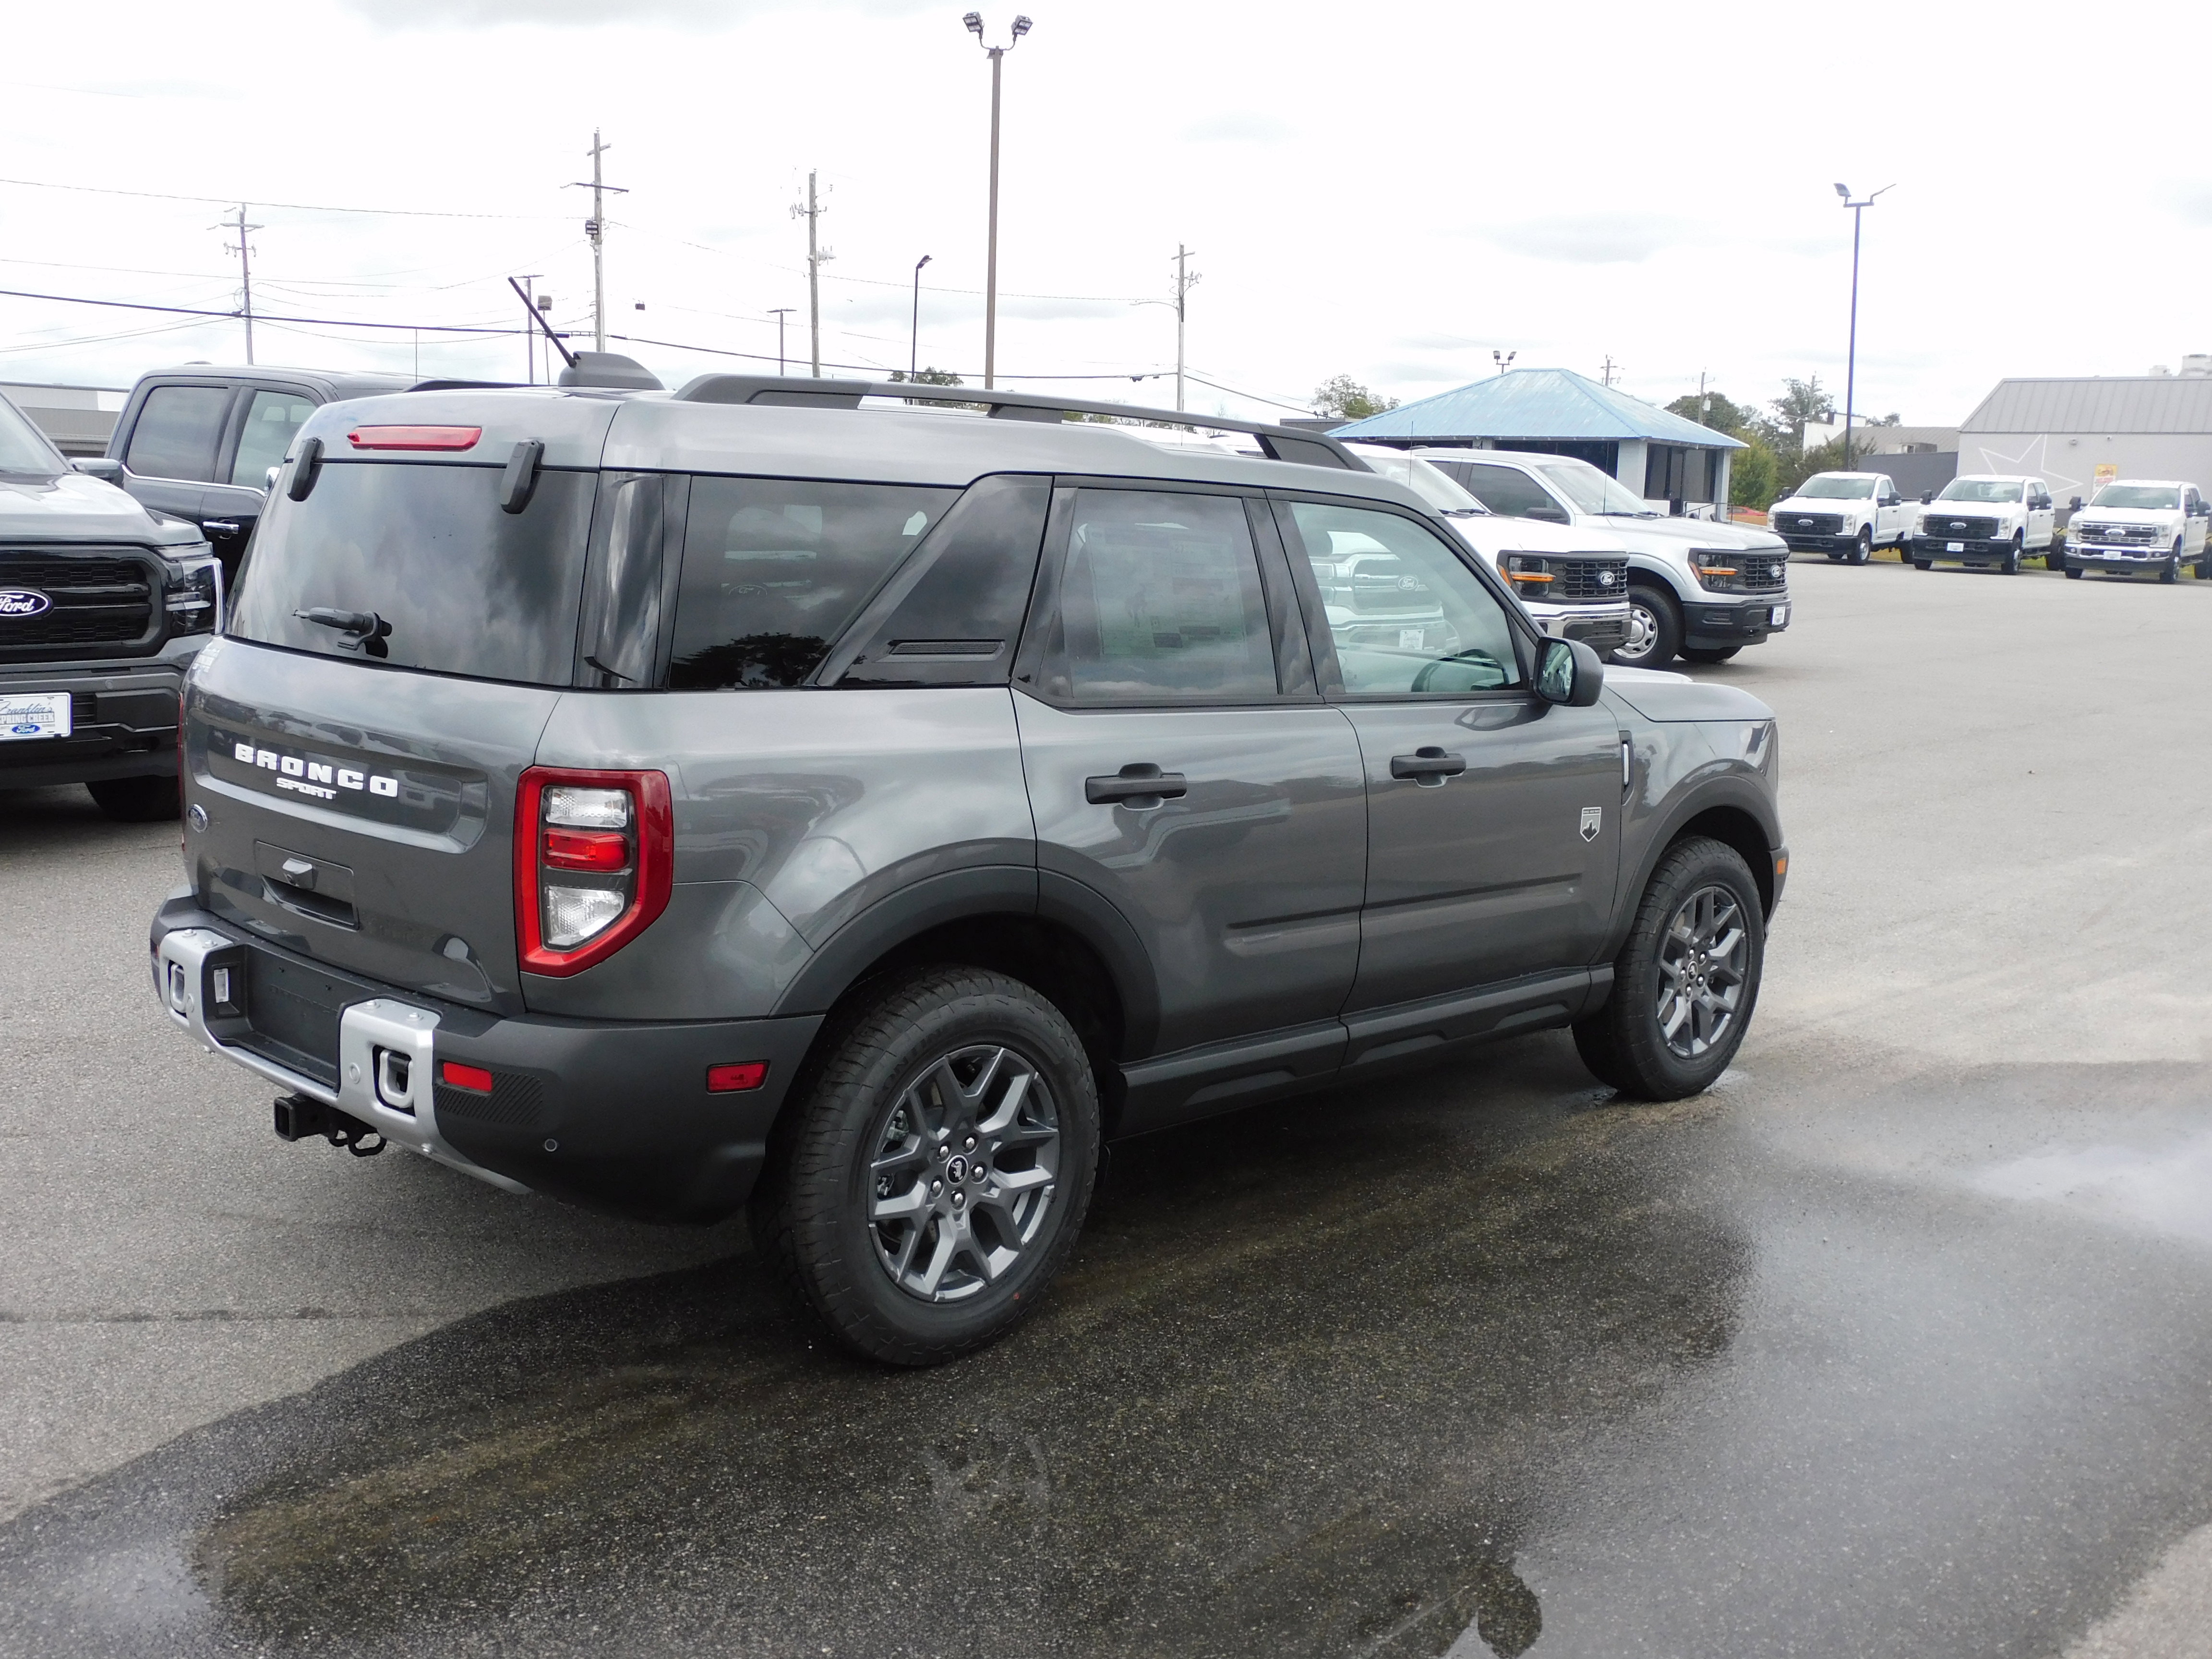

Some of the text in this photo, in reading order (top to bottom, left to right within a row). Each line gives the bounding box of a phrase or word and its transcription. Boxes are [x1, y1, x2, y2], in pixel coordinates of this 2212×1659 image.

[1402, 578, 1415, 588] Ford
[27, 712, 55, 723] CREEK
[16, 724, 36, 733] Ford
[234, 743, 398, 797] BRONCO
[276, 777, 337, 800] SPORT
